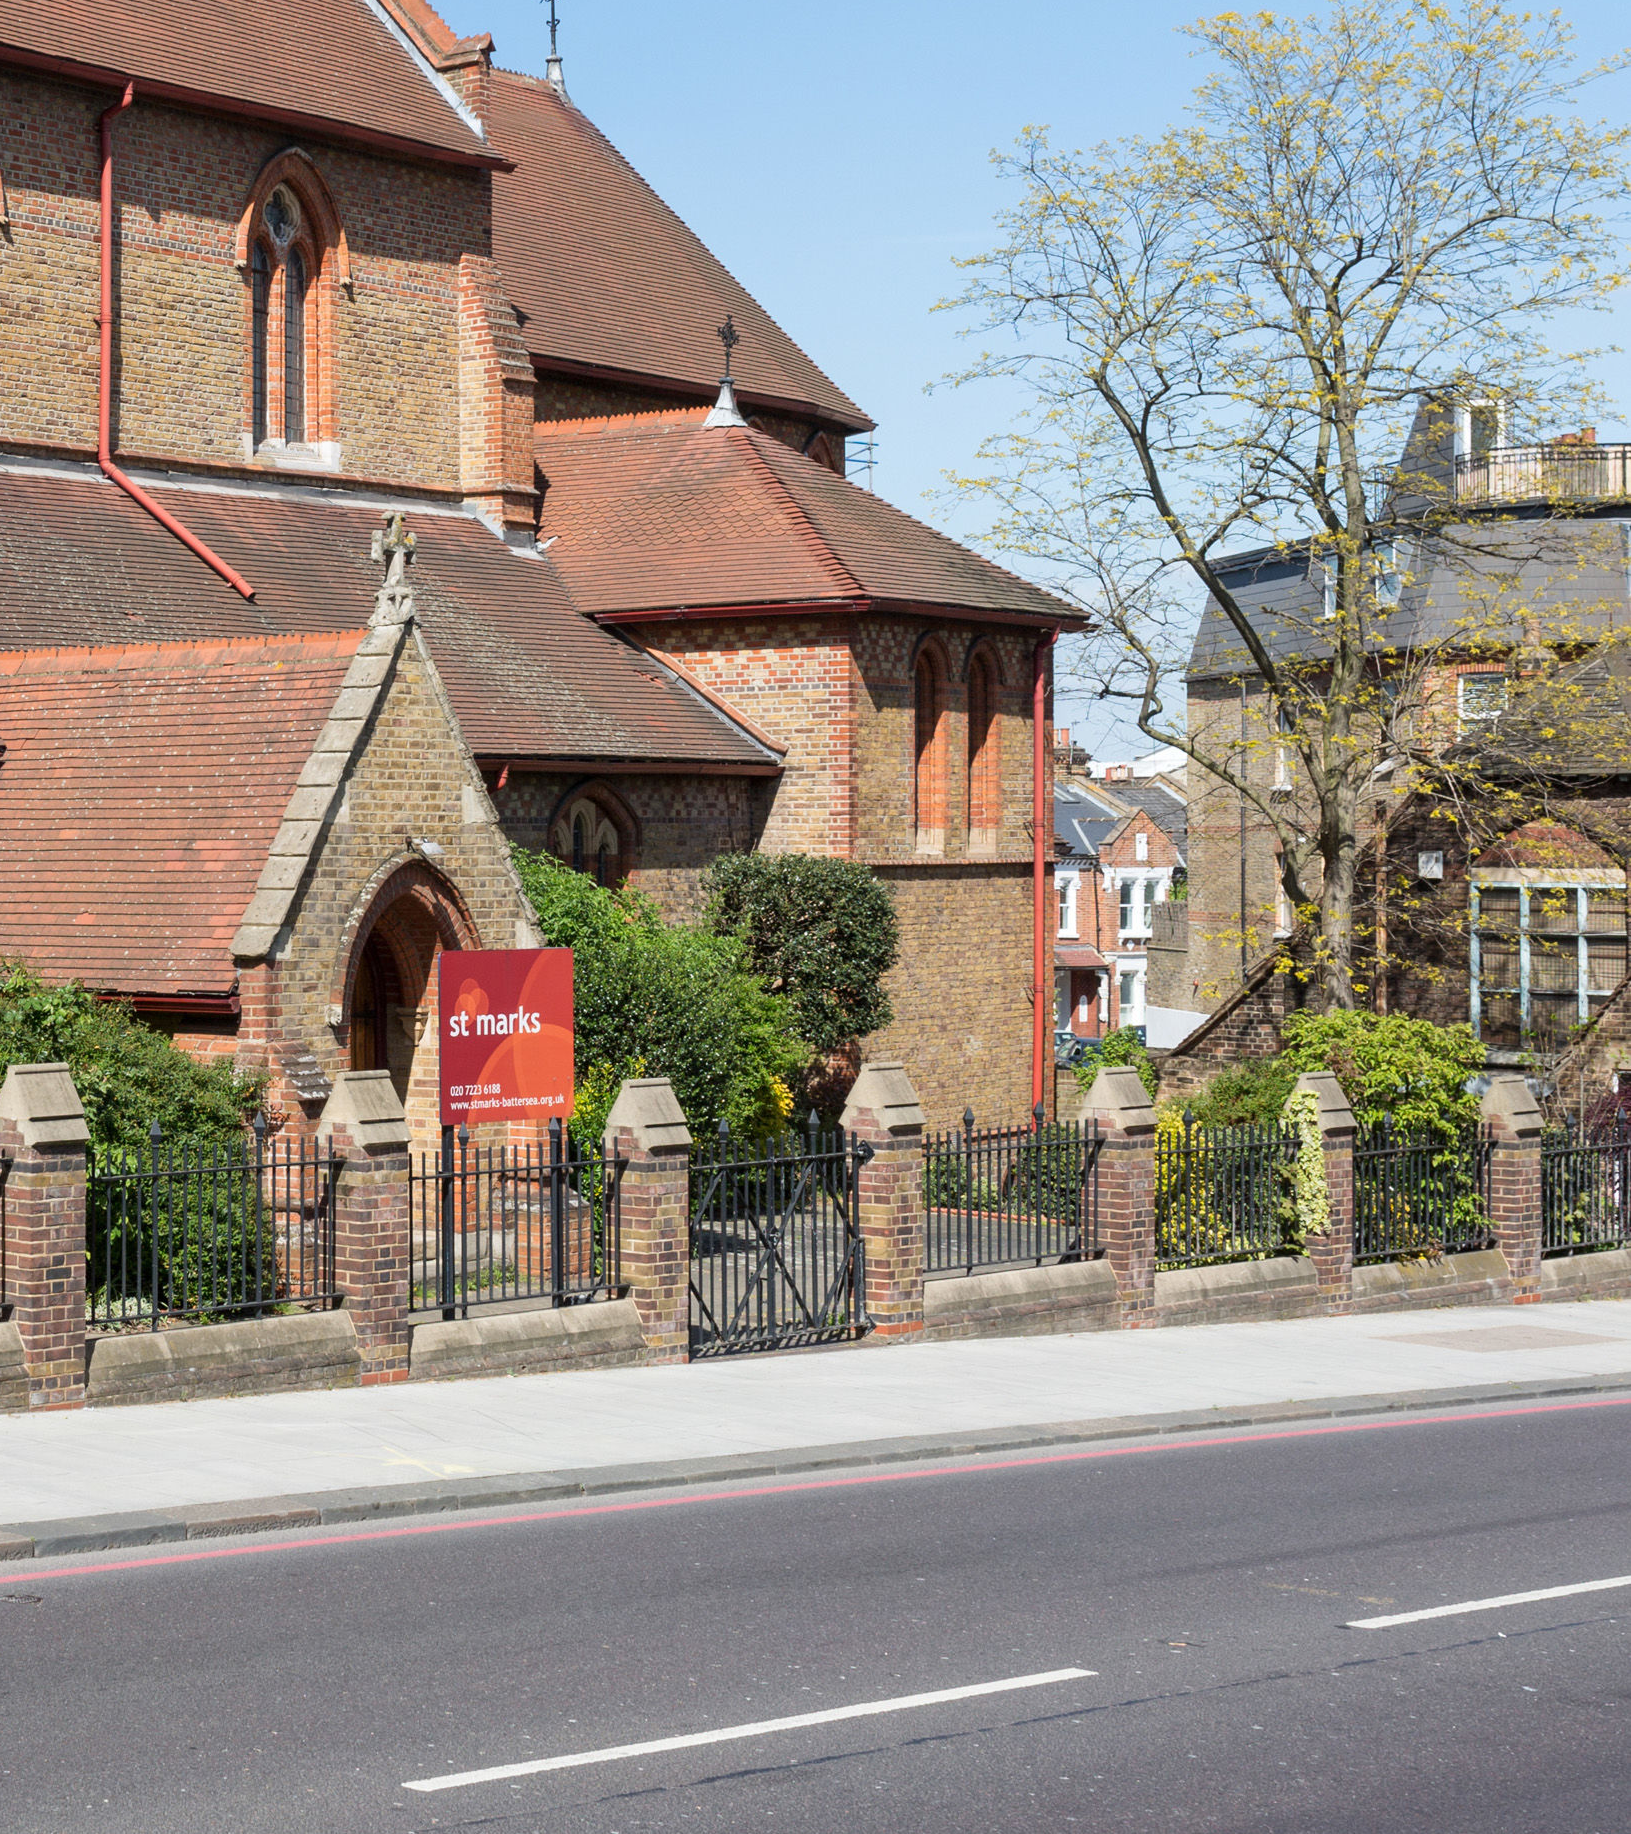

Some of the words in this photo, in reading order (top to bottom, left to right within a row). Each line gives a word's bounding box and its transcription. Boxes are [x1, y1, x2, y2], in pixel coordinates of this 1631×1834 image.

[449, 1011, 469, 1037] st
[476, 1005, 541, 1036] marks
[450, 1086, 463, 1097] 020
[465, 1084, 482, 1096] 7223
[483, 1083, 501, 1095] 6188
[450, 1094, 565, 1110] www.stmarks-battersea.org.uk
